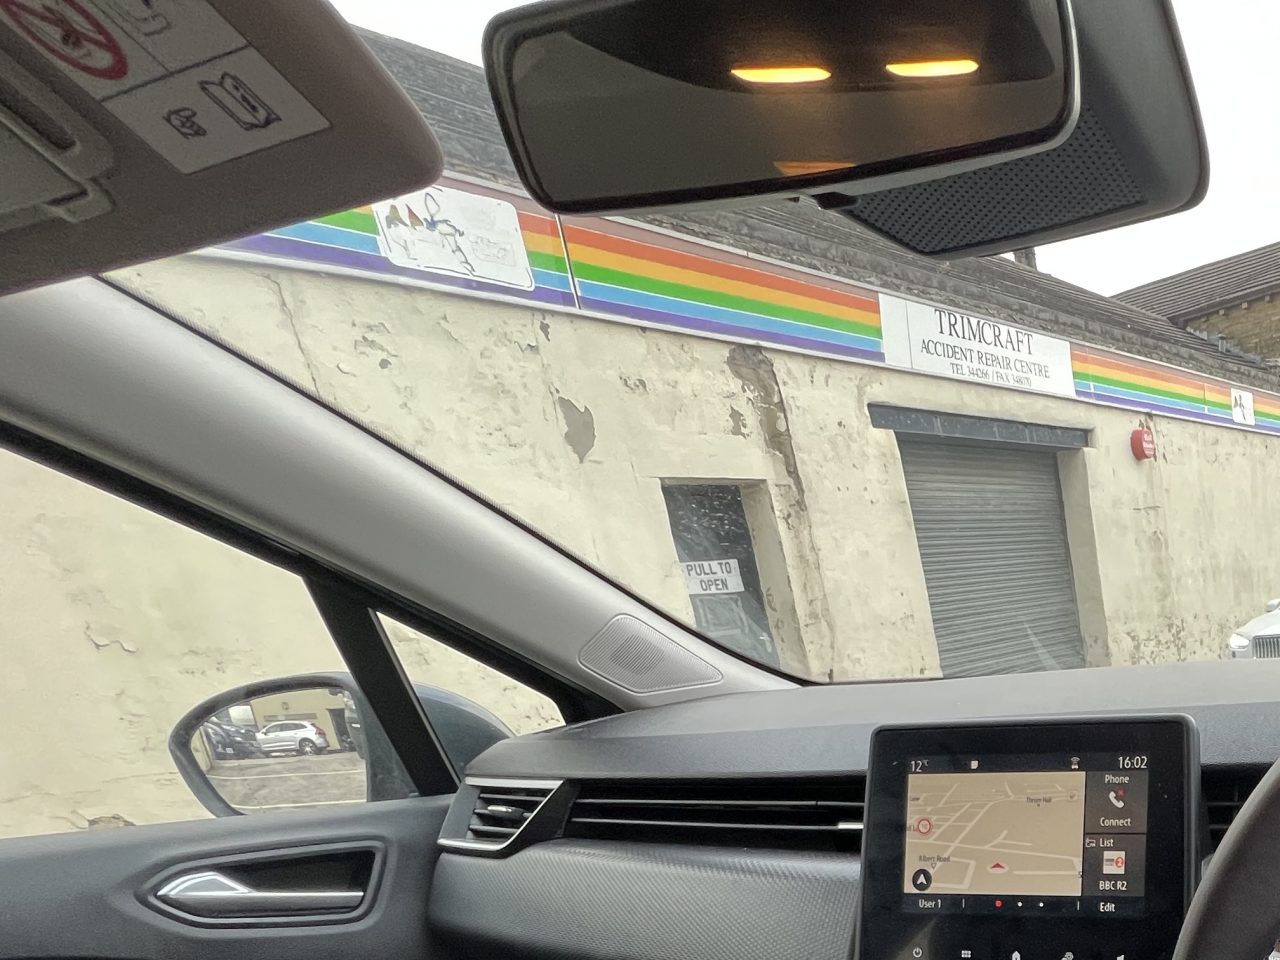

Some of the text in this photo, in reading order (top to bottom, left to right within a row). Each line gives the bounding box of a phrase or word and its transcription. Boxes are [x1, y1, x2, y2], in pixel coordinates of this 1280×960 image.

[934, 308, 1033, 355] TRIMCRAFT
[920, 339, 1050, 379] ACCIDENT REPAIR CENTRE
[950, 362, 966, 376] TEL
[996, 371, 1010, 384] FAX
[686, 561, 732, 577] PULL TO
[700, 578, 729, 592] OPEN
[1118, 756, 1148, 769] 16:02
[1104, 774, 1130, 784] Phone
[1100, 817, 1131, 826] Connect
[1100, 838, 1114, 847] List
[1099, 881, 1127, 890] BBC R2
[919, 899, 936, 908] User
[1100, 902, 1116, 912] Edit
